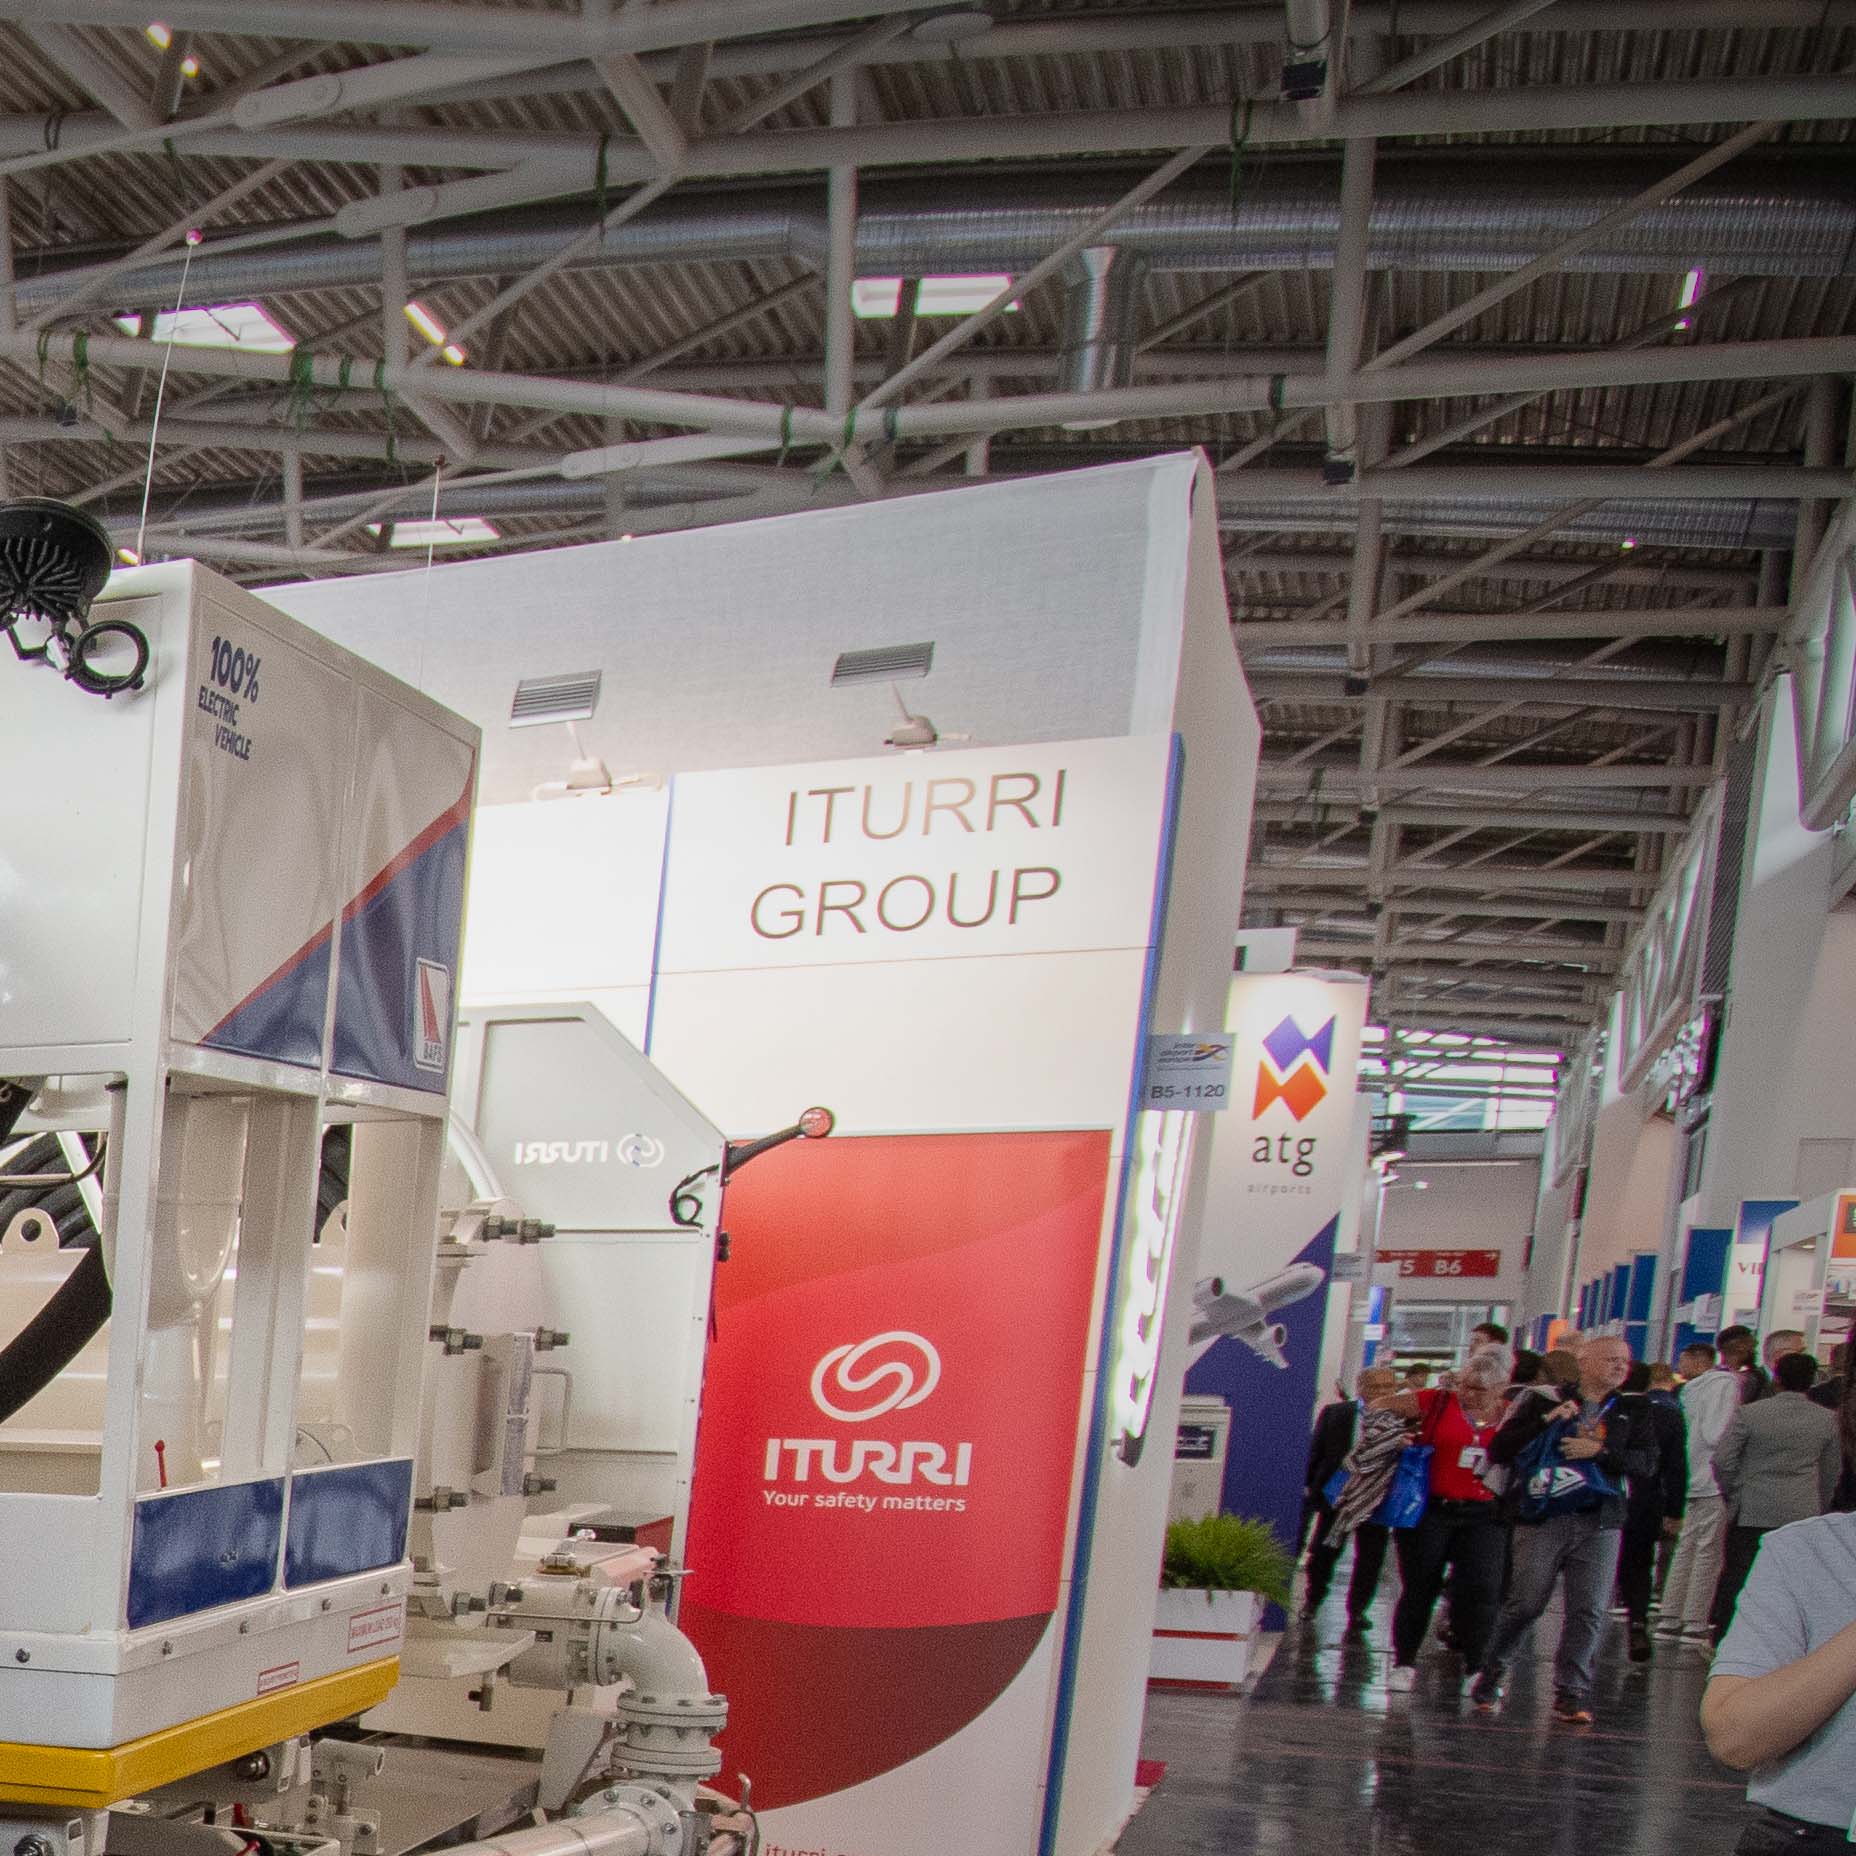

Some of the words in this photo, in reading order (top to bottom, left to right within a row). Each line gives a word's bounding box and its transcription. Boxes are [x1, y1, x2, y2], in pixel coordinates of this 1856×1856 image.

[210, 635, 261, 703] 100%
[198, 685, 240, 727] ELECTRIC
[215, 723, 252, 761] VEHICLE
[784, 767, 1067, 846] ITURRI
[750, 866, 1062, 940] GROUP
[1151, 1085, 1225, 1099] B5-1120
[1252, 1132, 1317, 1177] atg
[1248, 1184, 1311, 1196] airports
[1397, 1259, 1416, 1274] 5
[764, 1438, 972, 1486] ITURRI
[763, 1490, 809, 1507] Your
[815, 1492, 878, 1512] safety
[883, 1495, 966, 1512] matters
